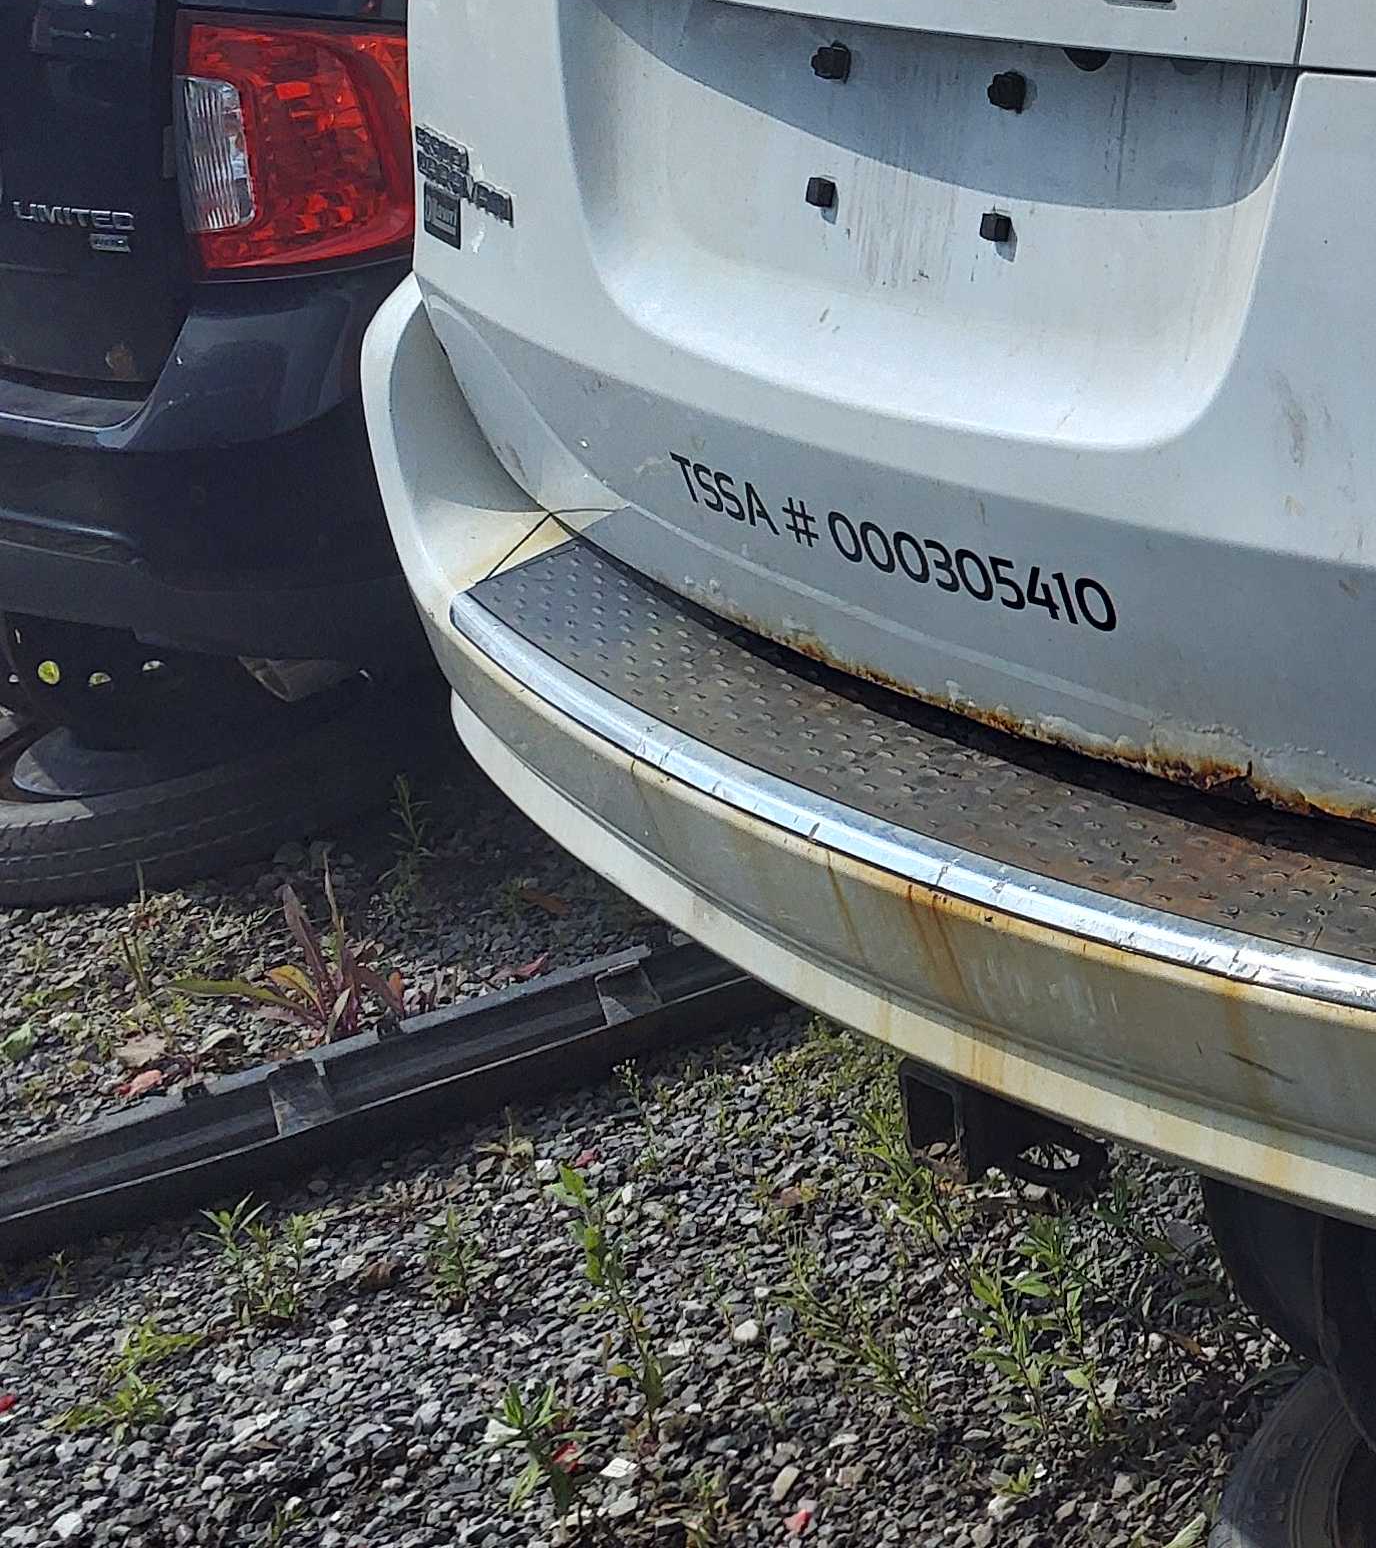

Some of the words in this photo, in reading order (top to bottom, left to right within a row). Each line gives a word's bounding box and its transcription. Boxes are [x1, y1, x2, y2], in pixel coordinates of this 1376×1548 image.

[13, 201, 135, 231] LIMITED
[669, 451, 780, 537] TSSA
[782, 497, 819, 547] #
[828, 511, 1117, 632] 000305410
